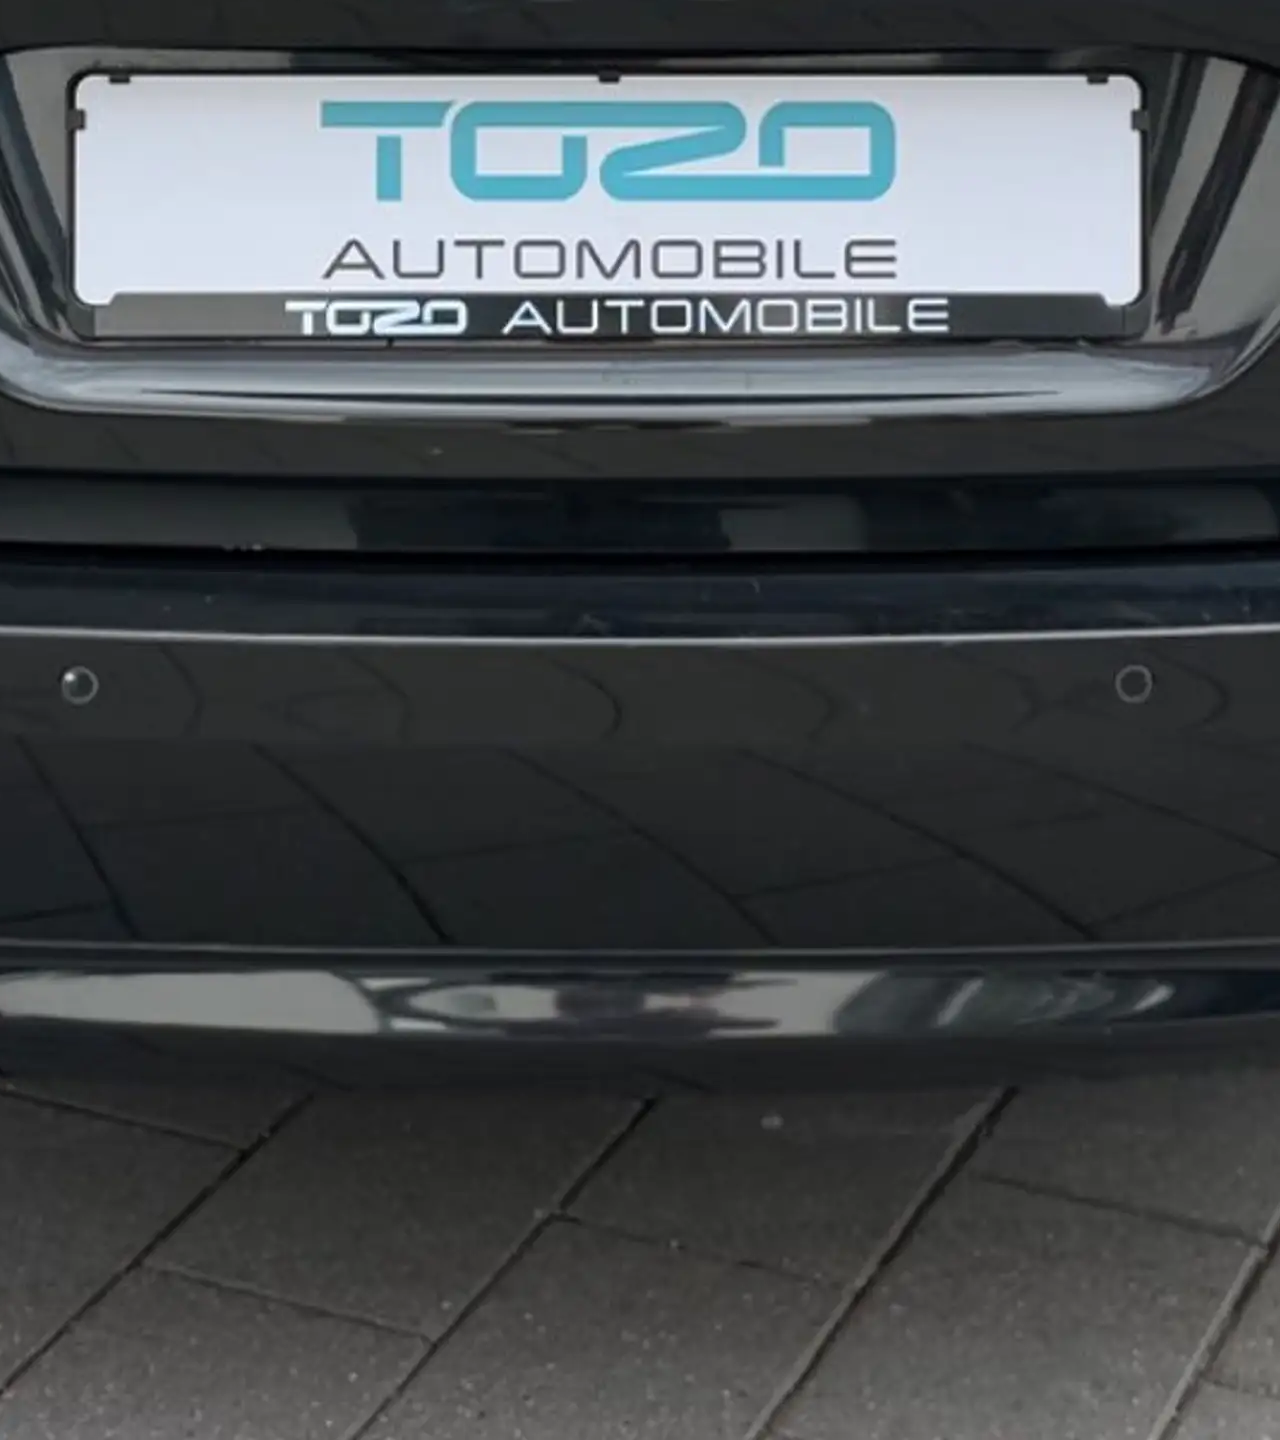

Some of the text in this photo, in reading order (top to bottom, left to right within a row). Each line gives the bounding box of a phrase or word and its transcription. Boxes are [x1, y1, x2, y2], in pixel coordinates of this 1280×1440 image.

[320, 100, 897, 202] TOZO
[321, 239, 898, 280] AUTOMOBILE
[284, 298, 949, 336] TOZO AUTOMOBILE
